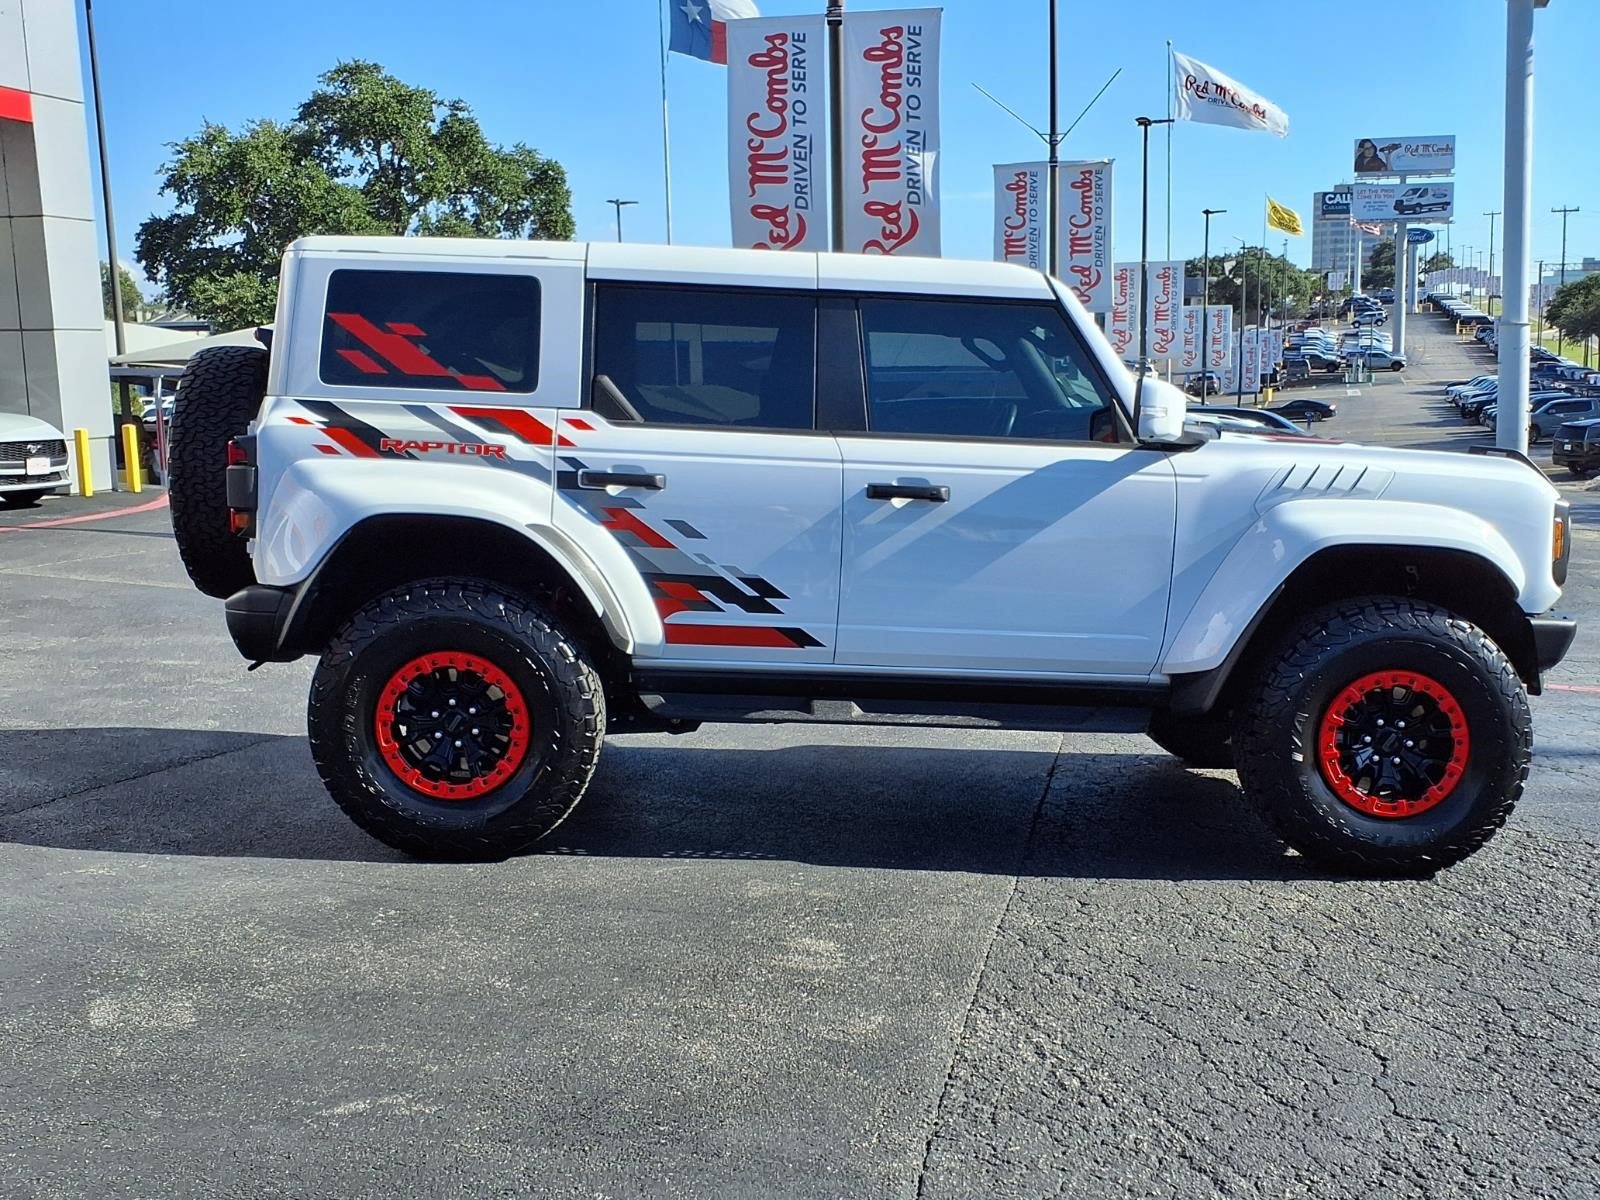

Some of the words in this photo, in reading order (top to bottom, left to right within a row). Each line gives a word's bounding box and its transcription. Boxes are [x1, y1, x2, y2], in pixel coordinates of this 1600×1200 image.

[792, 32, 807, 93] SERVE
[906, 25, 922, 89] SERVE
[1185, 74, 1209, 99] Red
[747, 32, 788, 197] McCombs
[792, 100, 808, 127] TO
[861, 26, 904, 194] McCombs
[906, 94, 921, 122] TO
[792, 134, 809, 210] DRIVEN
[905, 130, 921, 205] DRIVEN
[1029, 170, 1039, 205] SERVE
[1094, 168, 1104, 203] SERVE
[1004, 171, 1028, 261] McCombs
[1029, 207, 1038, 226] TO
[1069, 169, 1093, 261] McCombs
[1095, 206, 1104, 224] TO
[1029, 227, 1038, 269] DRIVEN
[1094, 225, 1103, 268] DRIVEN
[1070, 265, 1101, 304] Red
[1112, 268, 1128, 326] McCombs
[1154, 266, 1170, 325] McCombs
[1111, 328, 1133, 354] Red
[1152, 328, 1175, 354] Red
[380, 438, 509, 461] RAPTOR
